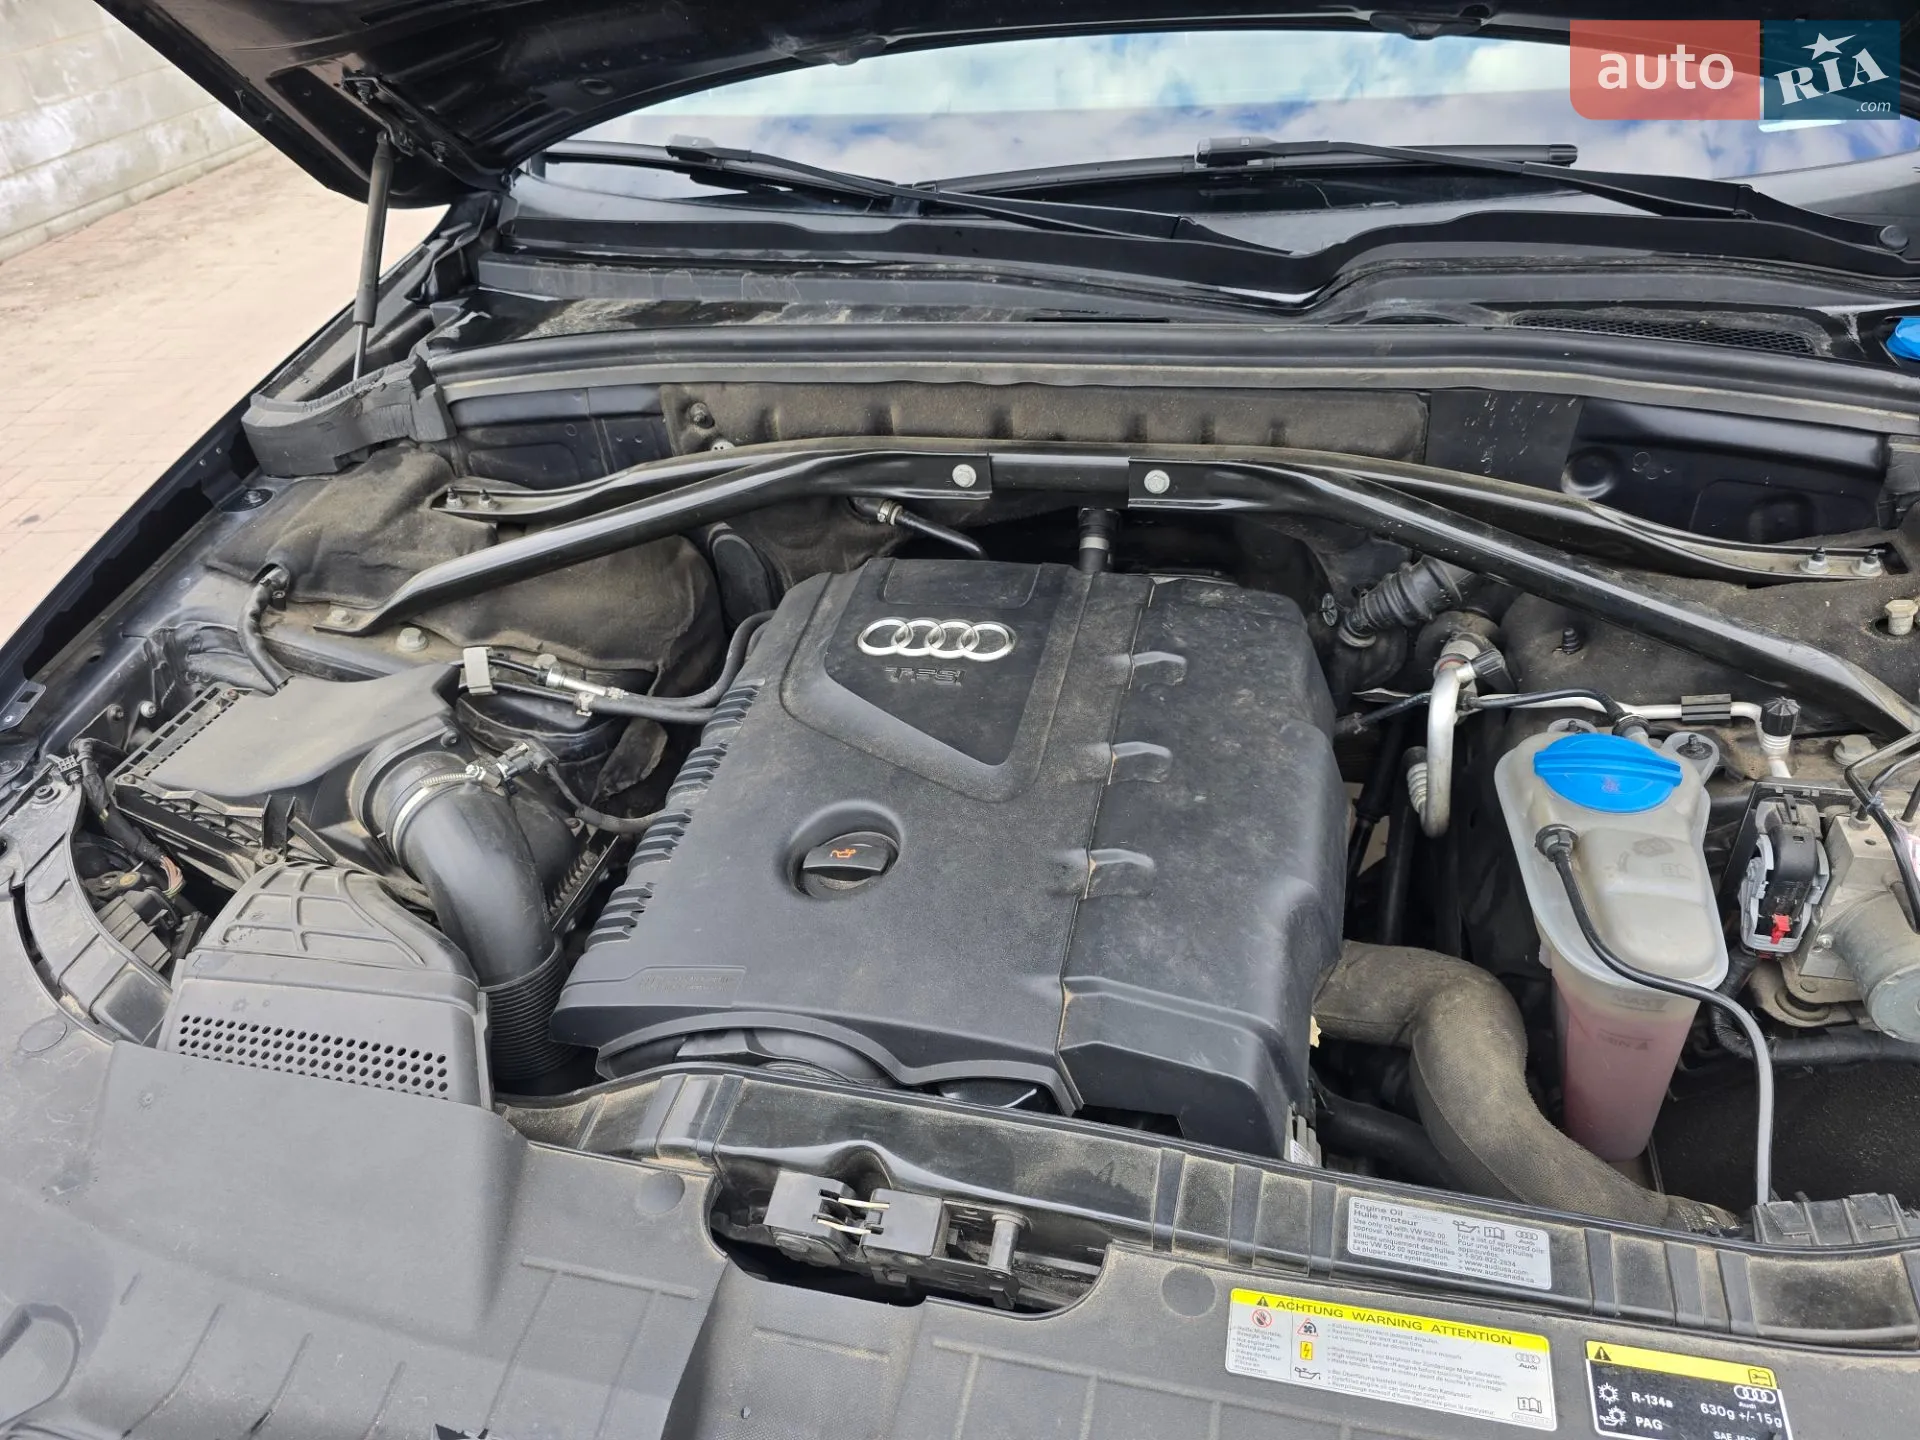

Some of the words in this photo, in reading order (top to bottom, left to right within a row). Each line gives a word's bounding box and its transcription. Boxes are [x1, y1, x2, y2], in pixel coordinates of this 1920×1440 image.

[884, 667, 966, 687] TFSI
[1354, 1201, 1386, 1214] Engine
[1389, 1207, 1402, 1216] Oil
[1353, 1209, 1377, 1219] Huile
[1380, 1215, 1418, 1226] moteur
[1367, 1220, 1381, 1228] only
[1386, 1229, 1402, 1237] Most
[1457, 1238, 1473, 1247] Pour
[1362, 1246, 1385, 1256] plupart
[1275, 1300, 1344, 1319] ACHTUNG
[1352, 1311, 1423, 1331] WARNING
[1431, 1324, 1512, 1345] ATTENTION
[1517, 1361, 1537, 1369] Audi
[1631, 1391, 1674, 1408] R-134a
[1700, 1403, 1735, 1421] 630g
[1635, 1416, 1664, 1431] PAG
[1713, 1431, 1733, 1440] SAE
